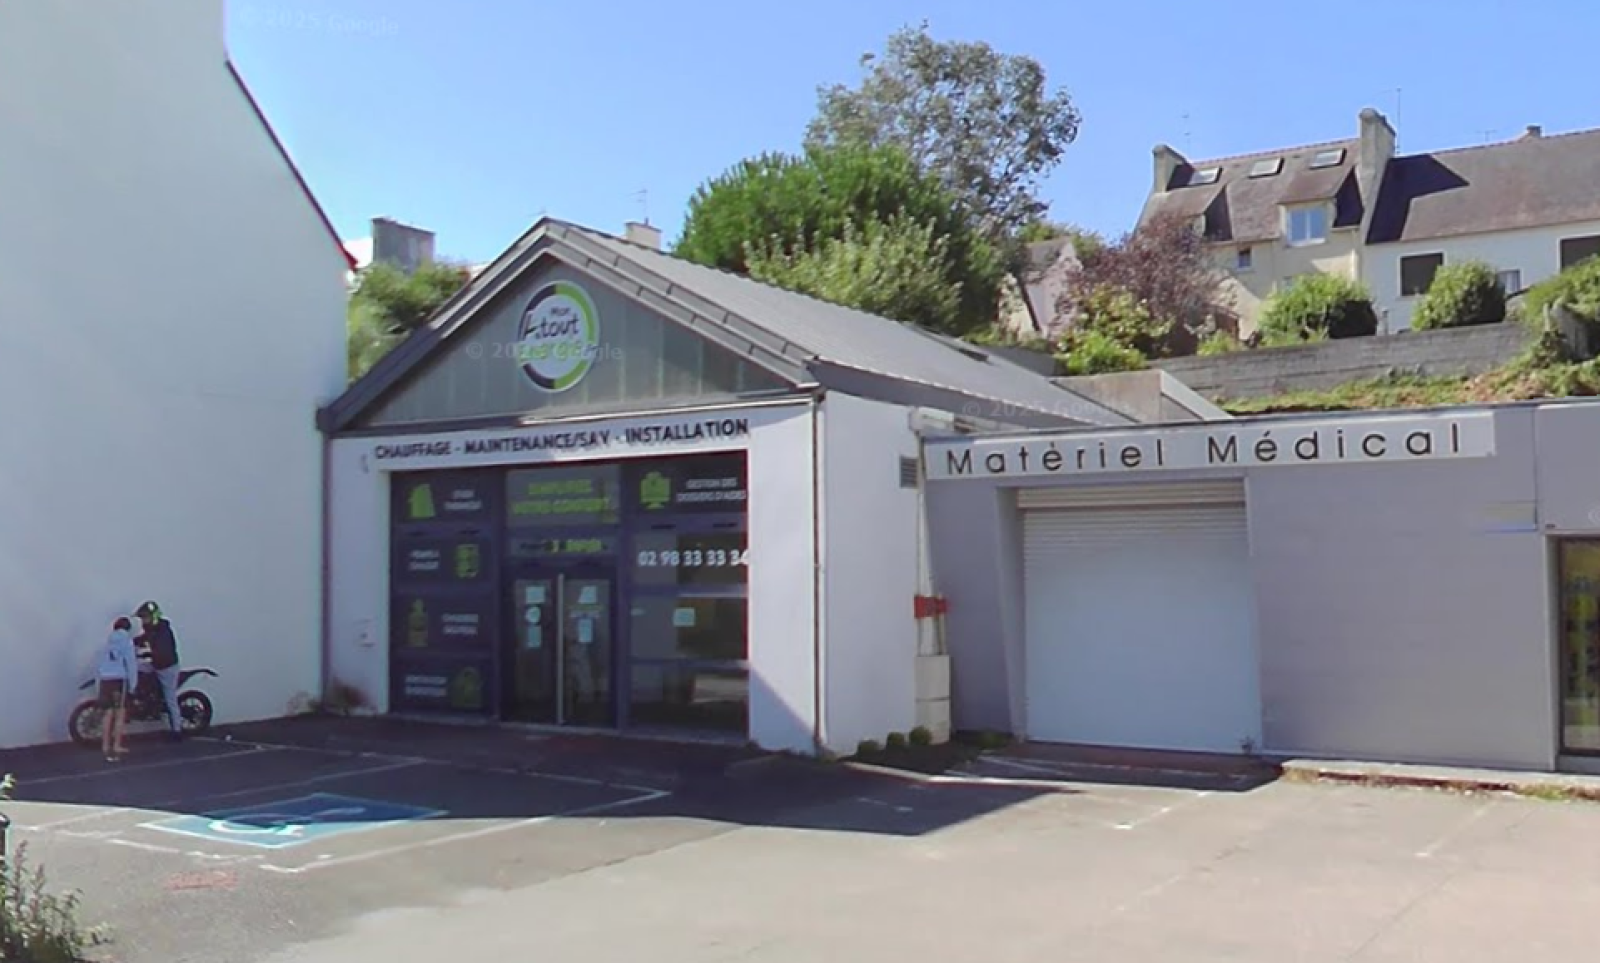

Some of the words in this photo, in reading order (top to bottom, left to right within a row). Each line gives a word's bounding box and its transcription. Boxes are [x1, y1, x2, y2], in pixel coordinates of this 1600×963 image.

[375, 440, 452, 460] CHAUFFAGE
[625, 418, 748, 443] INSTALLATION
[1207, 423, 1460, 464] Médical
[638, 550, 657, 567] 02
[660, 550, 680, 567] 98
[683, 549, 703, 567] 33
[706, 549, 727, 566] 33
